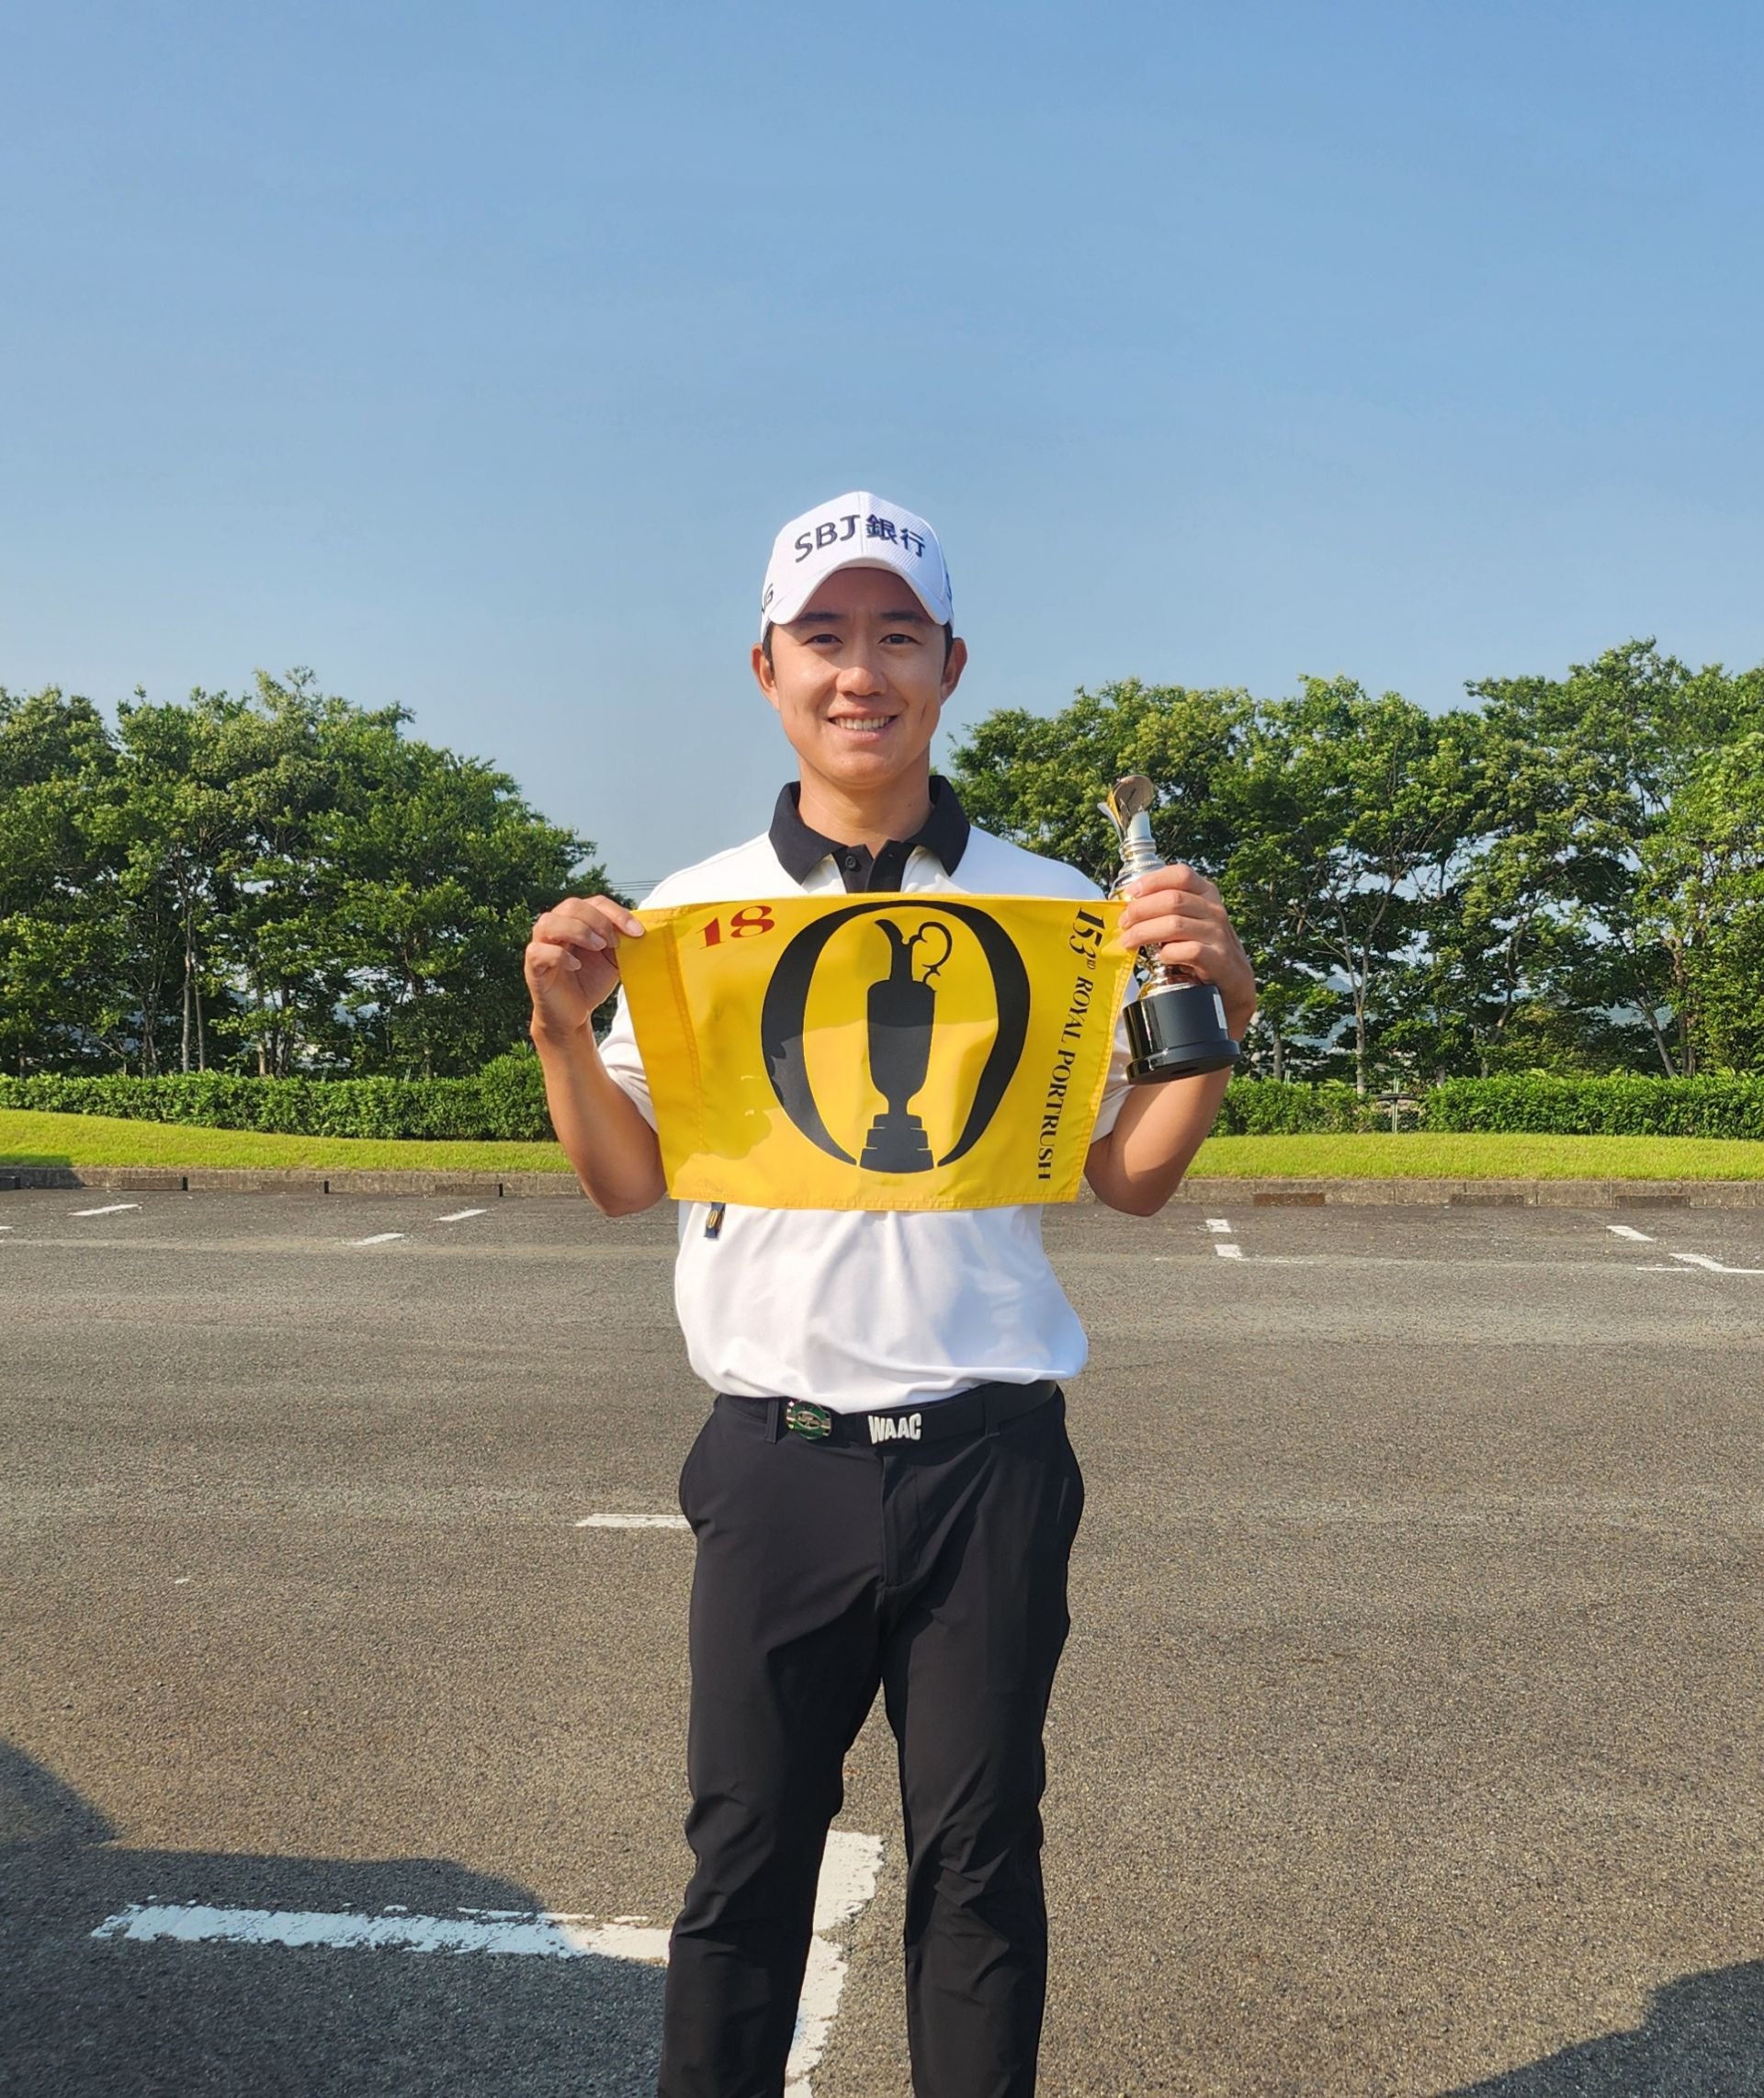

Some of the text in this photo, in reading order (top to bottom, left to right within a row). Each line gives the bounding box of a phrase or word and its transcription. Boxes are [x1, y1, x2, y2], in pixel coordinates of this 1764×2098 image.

[695, 904, 775, 950] 18
[1061, 976, 1094, 1043] ROYAL
[1038, 1050, 1076, 1180] PORTRUSH
[867, 1412, 922, 1445] WAAC
